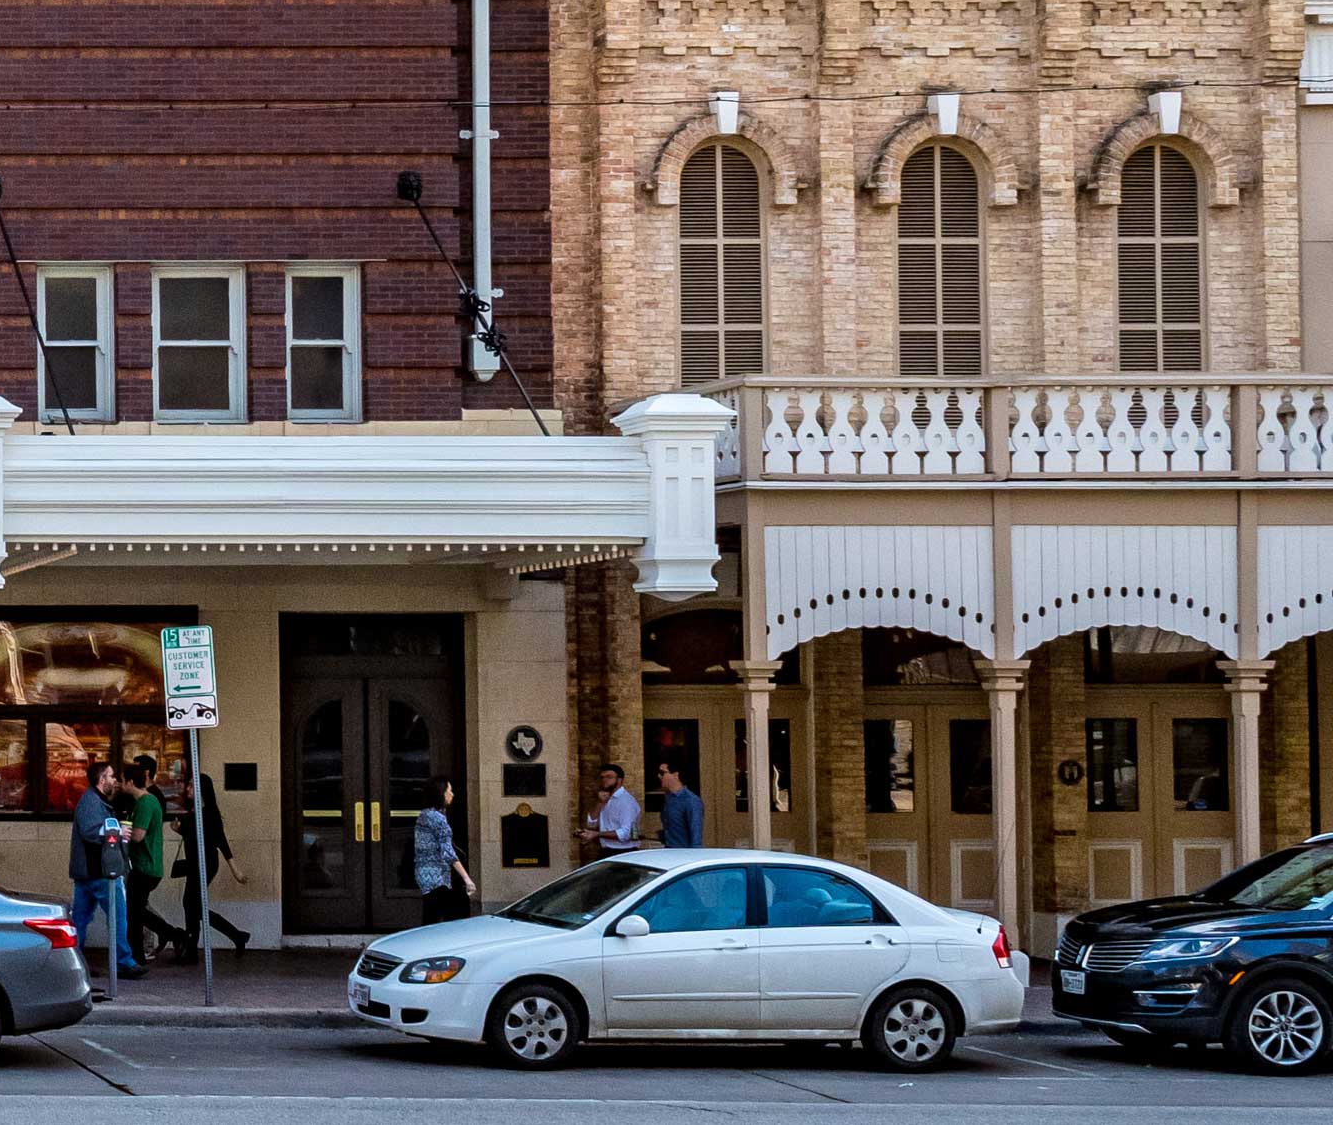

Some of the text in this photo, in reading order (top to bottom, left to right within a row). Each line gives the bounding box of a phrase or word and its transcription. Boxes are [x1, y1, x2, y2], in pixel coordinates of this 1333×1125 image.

[165, 629, 177, 642] 15
[168, 650, 209, 660] CUSTOMER
[173, 661, 205, 671] SERVICE
[179, 671, 200, 680] ZONE
